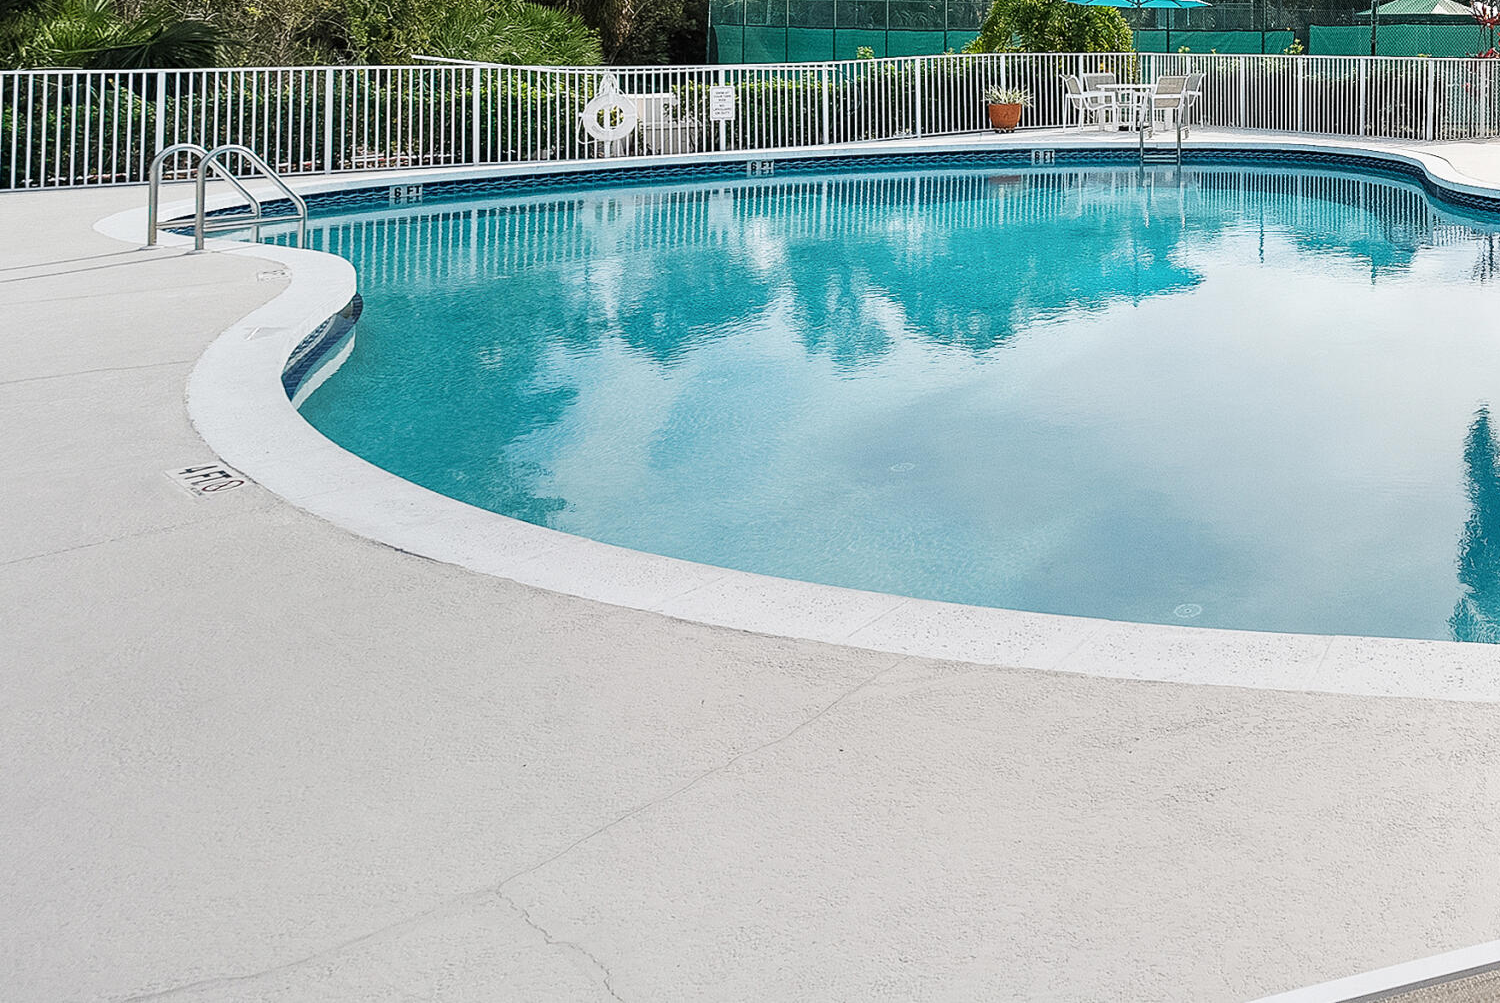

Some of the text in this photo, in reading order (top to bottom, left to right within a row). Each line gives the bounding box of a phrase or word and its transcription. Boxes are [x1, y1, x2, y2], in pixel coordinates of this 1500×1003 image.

[761, 160, 774, 168] FT
[394, 185, 421, 197] 6 FT
